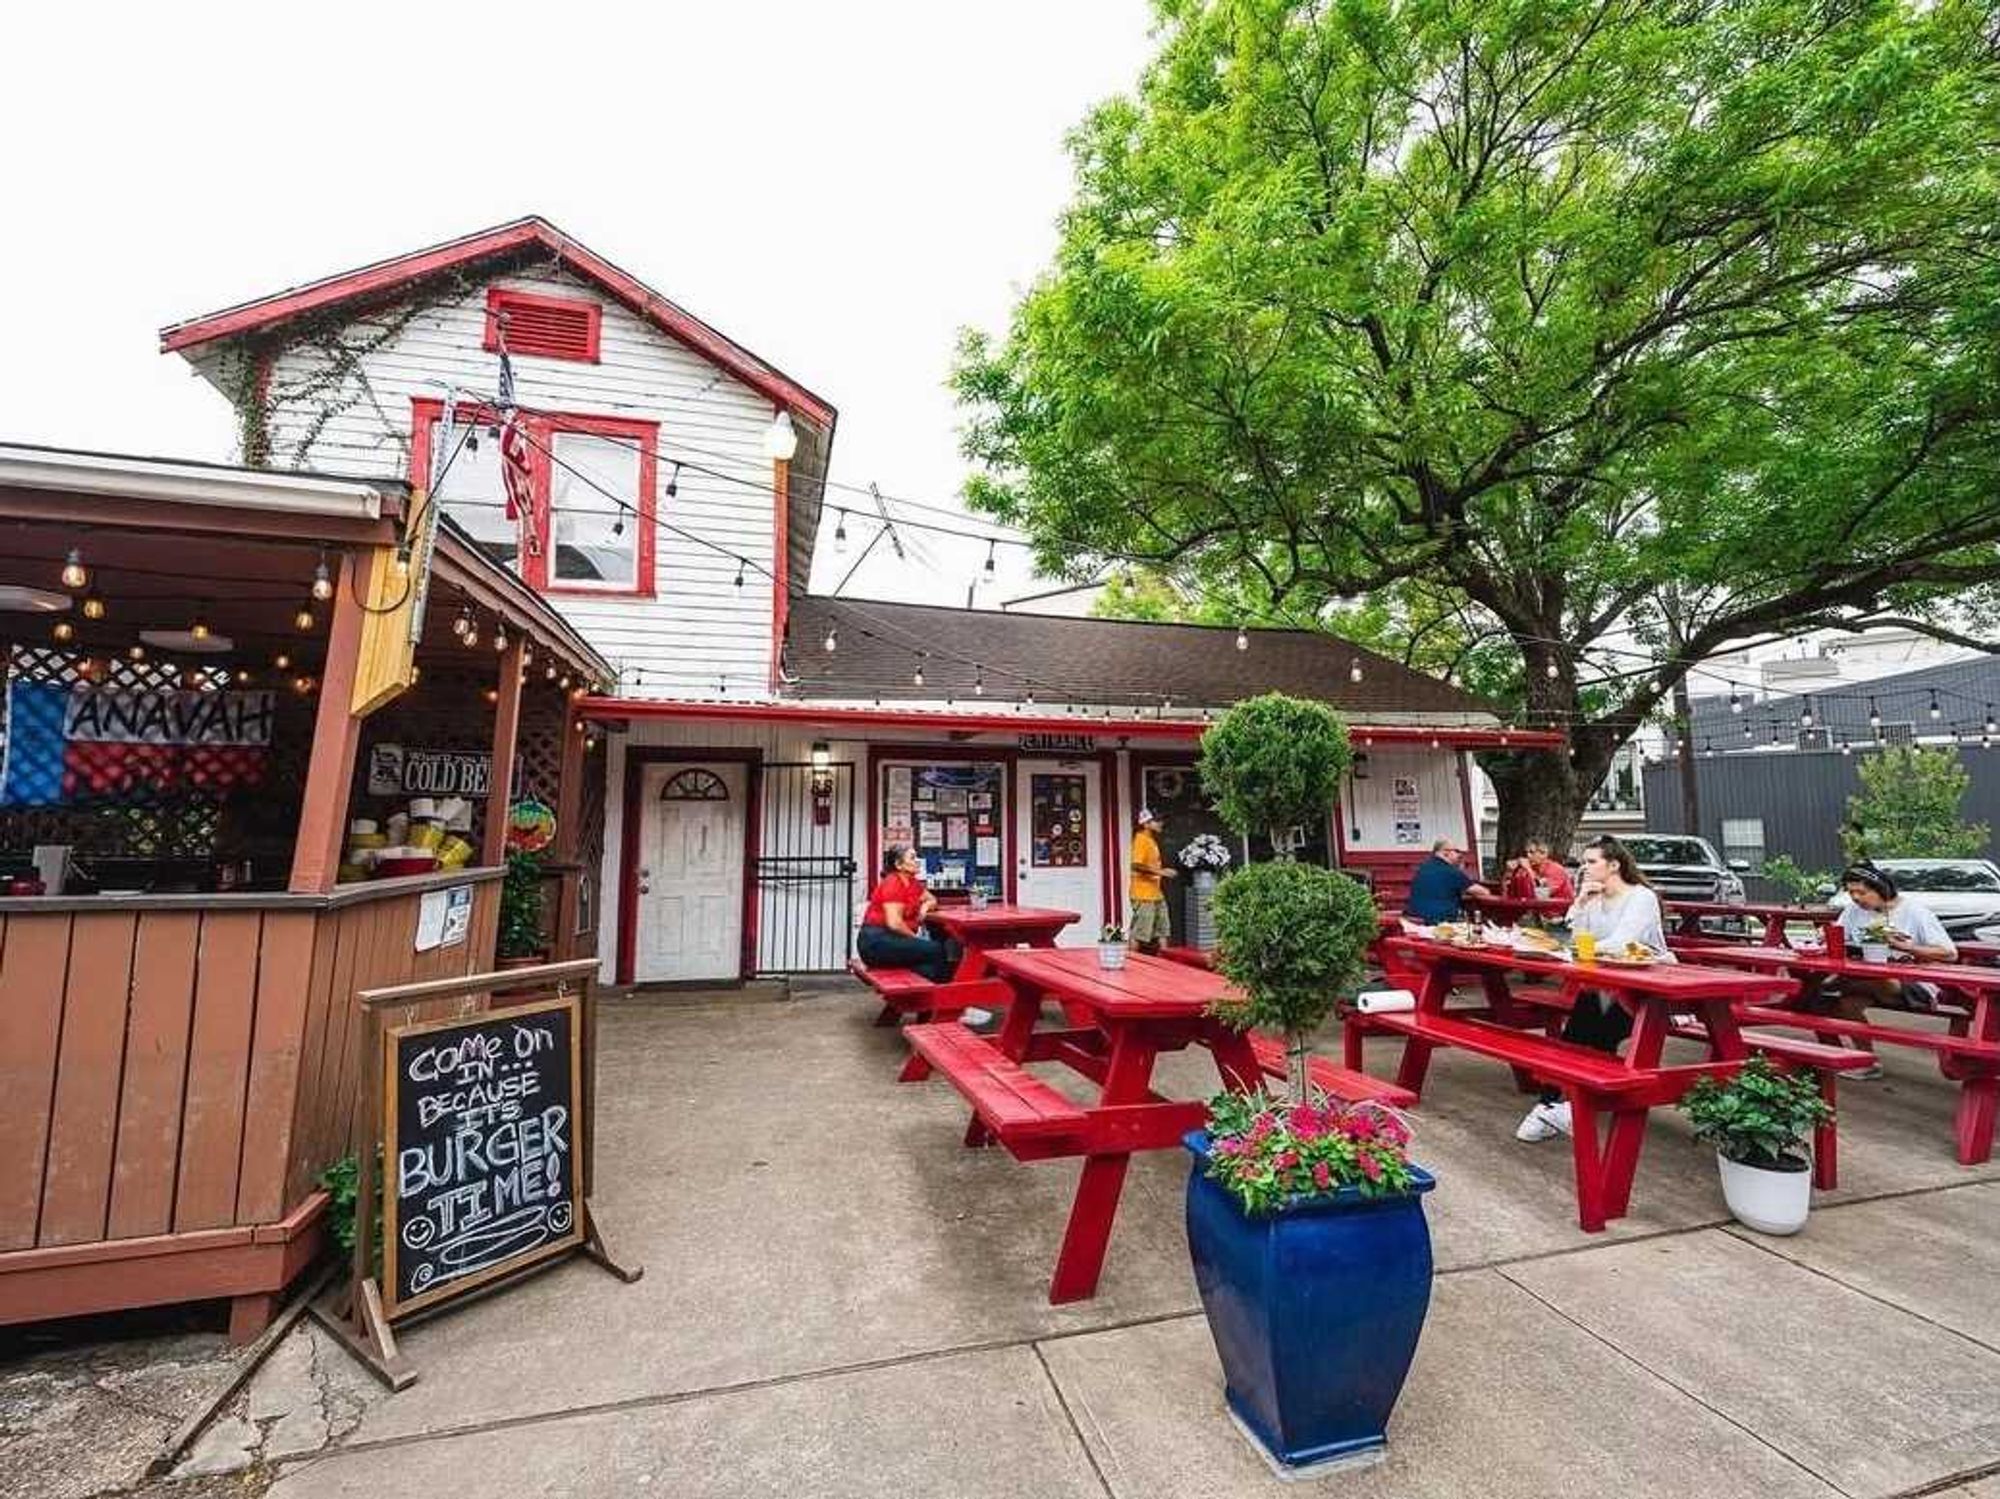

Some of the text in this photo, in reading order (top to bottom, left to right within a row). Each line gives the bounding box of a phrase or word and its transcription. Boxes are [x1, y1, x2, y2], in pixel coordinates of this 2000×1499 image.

[70, 692, 270, 741] ANAVAH
[405, 761, 494, 793] COLD BE
[417, 1071, 541, 1128] BECAUSE
[399, 1105, 568, 1198] BURGER
